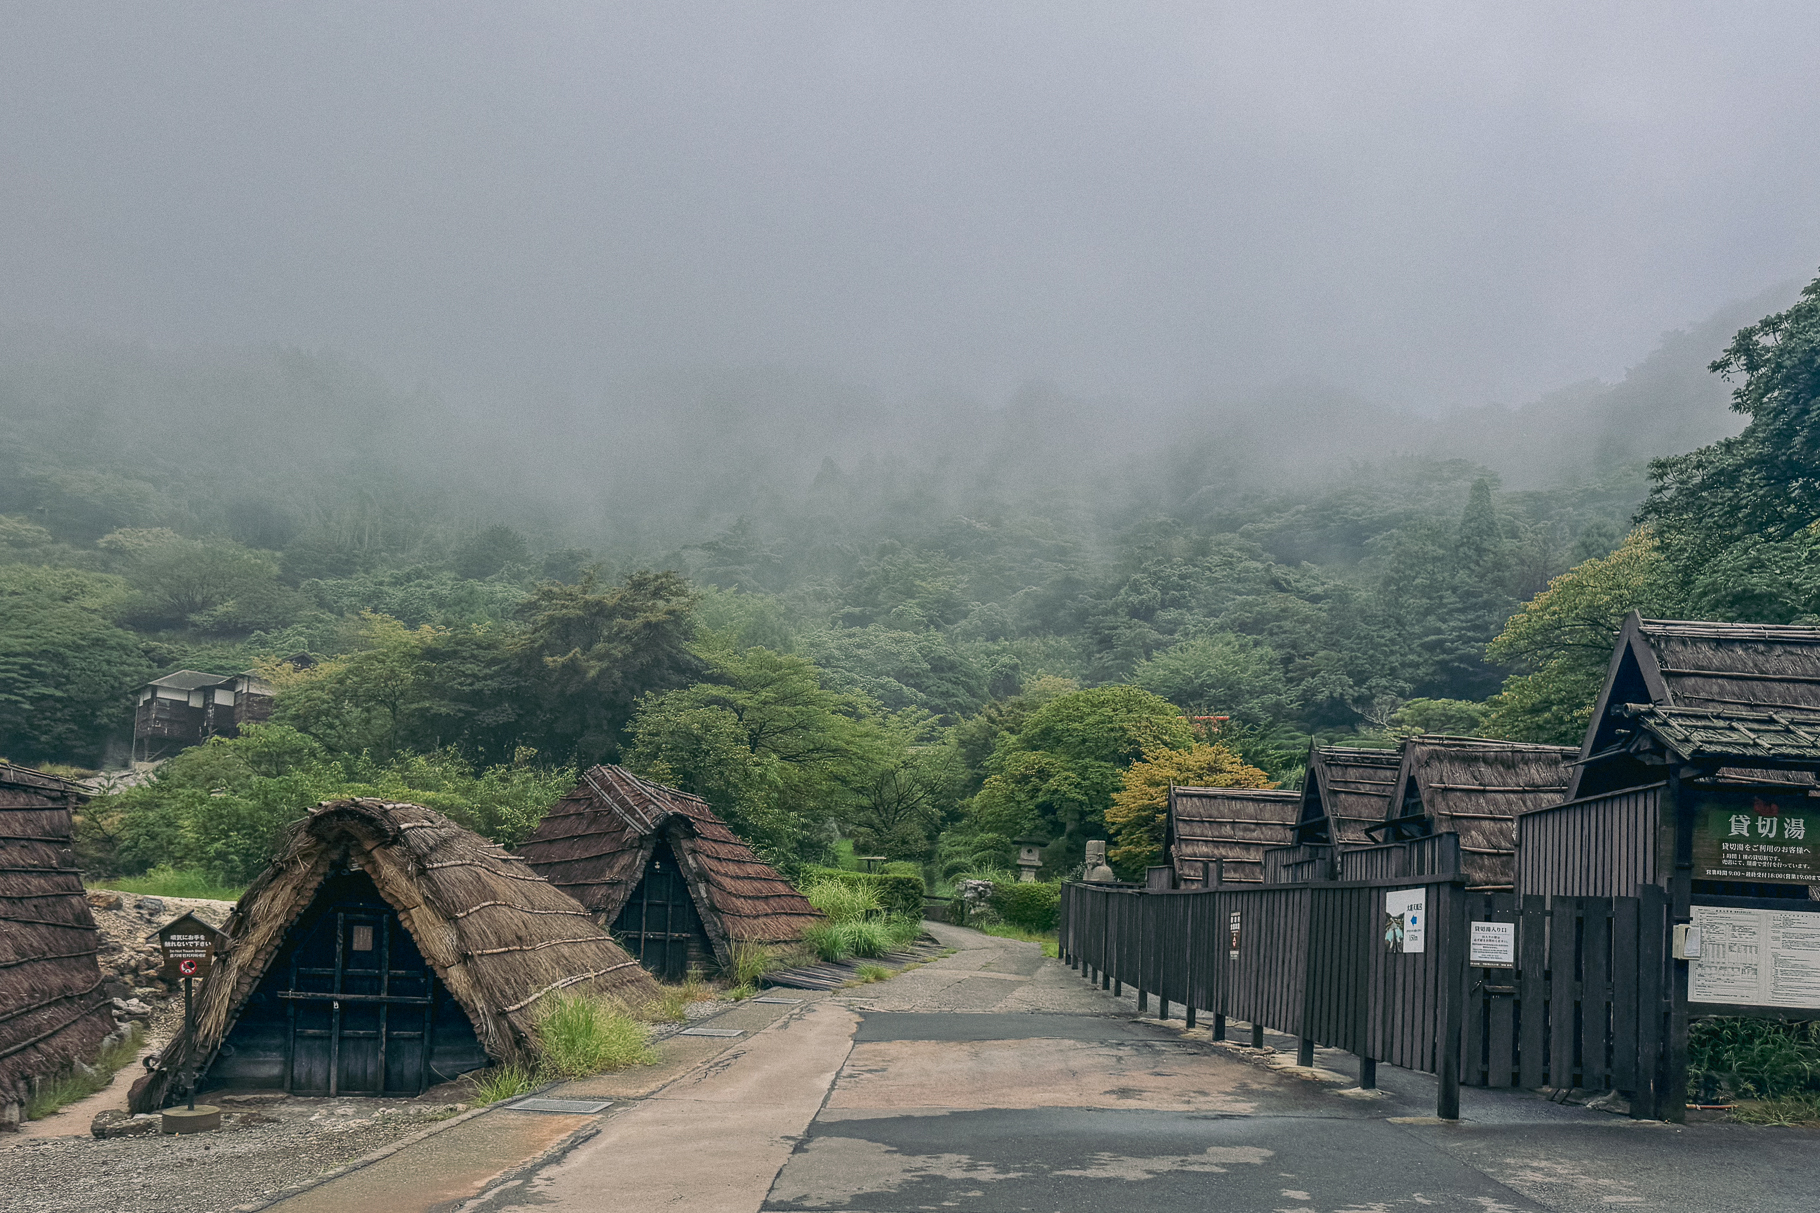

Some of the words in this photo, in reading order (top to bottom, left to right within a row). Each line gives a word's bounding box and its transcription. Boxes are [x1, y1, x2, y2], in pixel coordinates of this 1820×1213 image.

[1728, 814, 1806, 839] 貸切湯
[1722, 842, 1811, 854] 貸切湯をご利用のお客様へ
